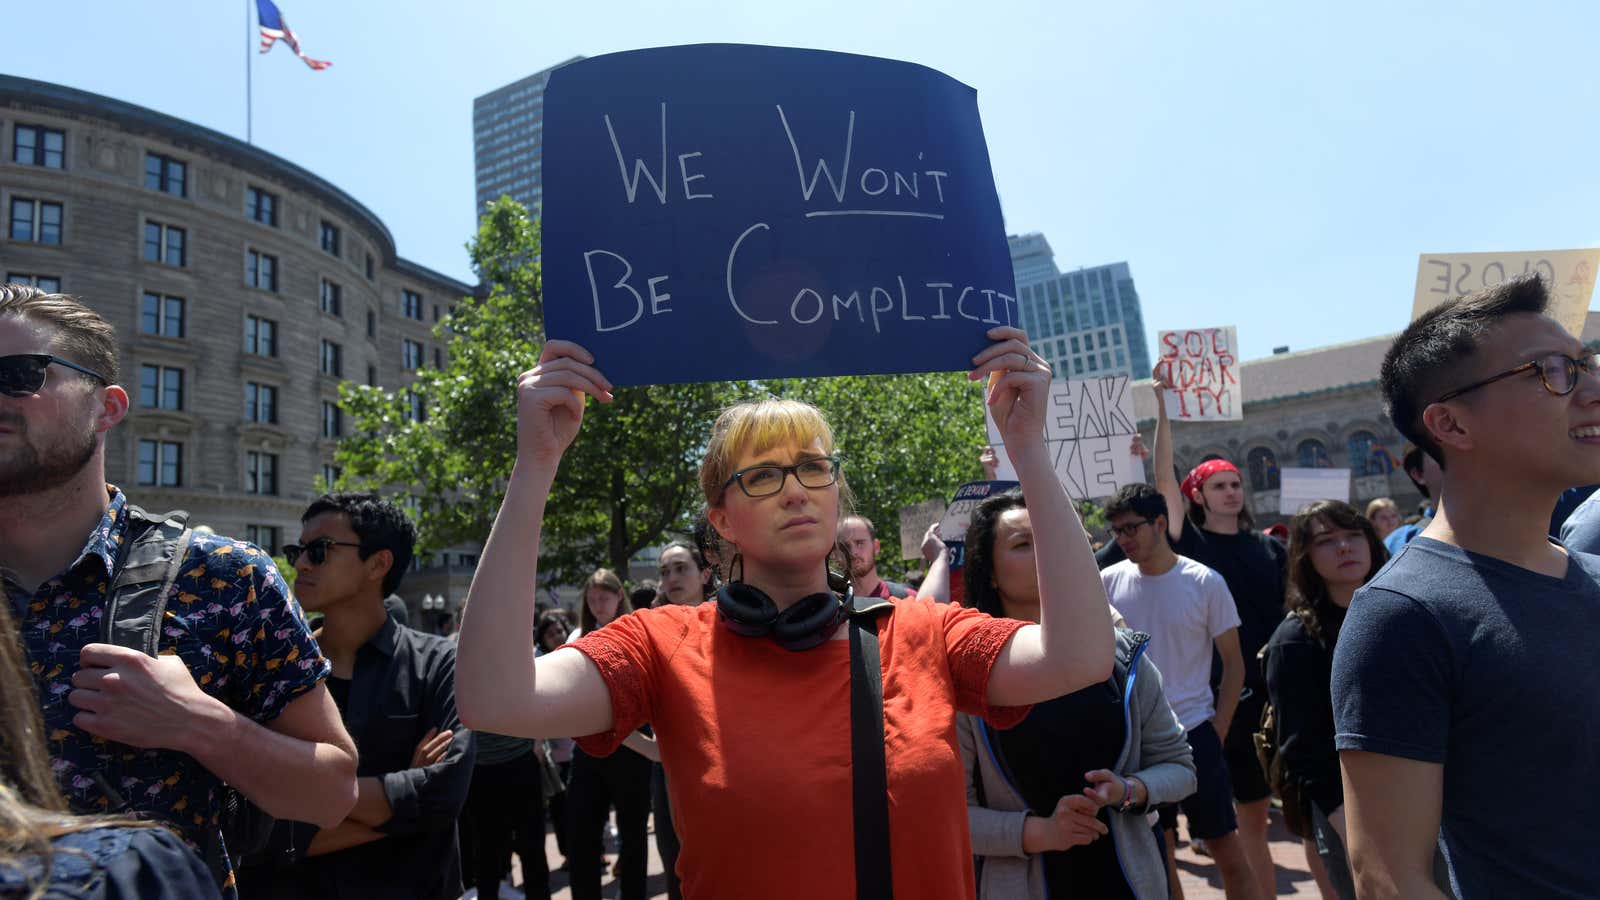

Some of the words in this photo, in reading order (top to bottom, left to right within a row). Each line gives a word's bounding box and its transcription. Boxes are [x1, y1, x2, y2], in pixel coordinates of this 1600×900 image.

[604, 102, 713, 204] WE
[776, 104, 948, 203] WON'T
[583, 249, 673, 332] BE
[726, 222, 1016, 334] COMPLICIT
